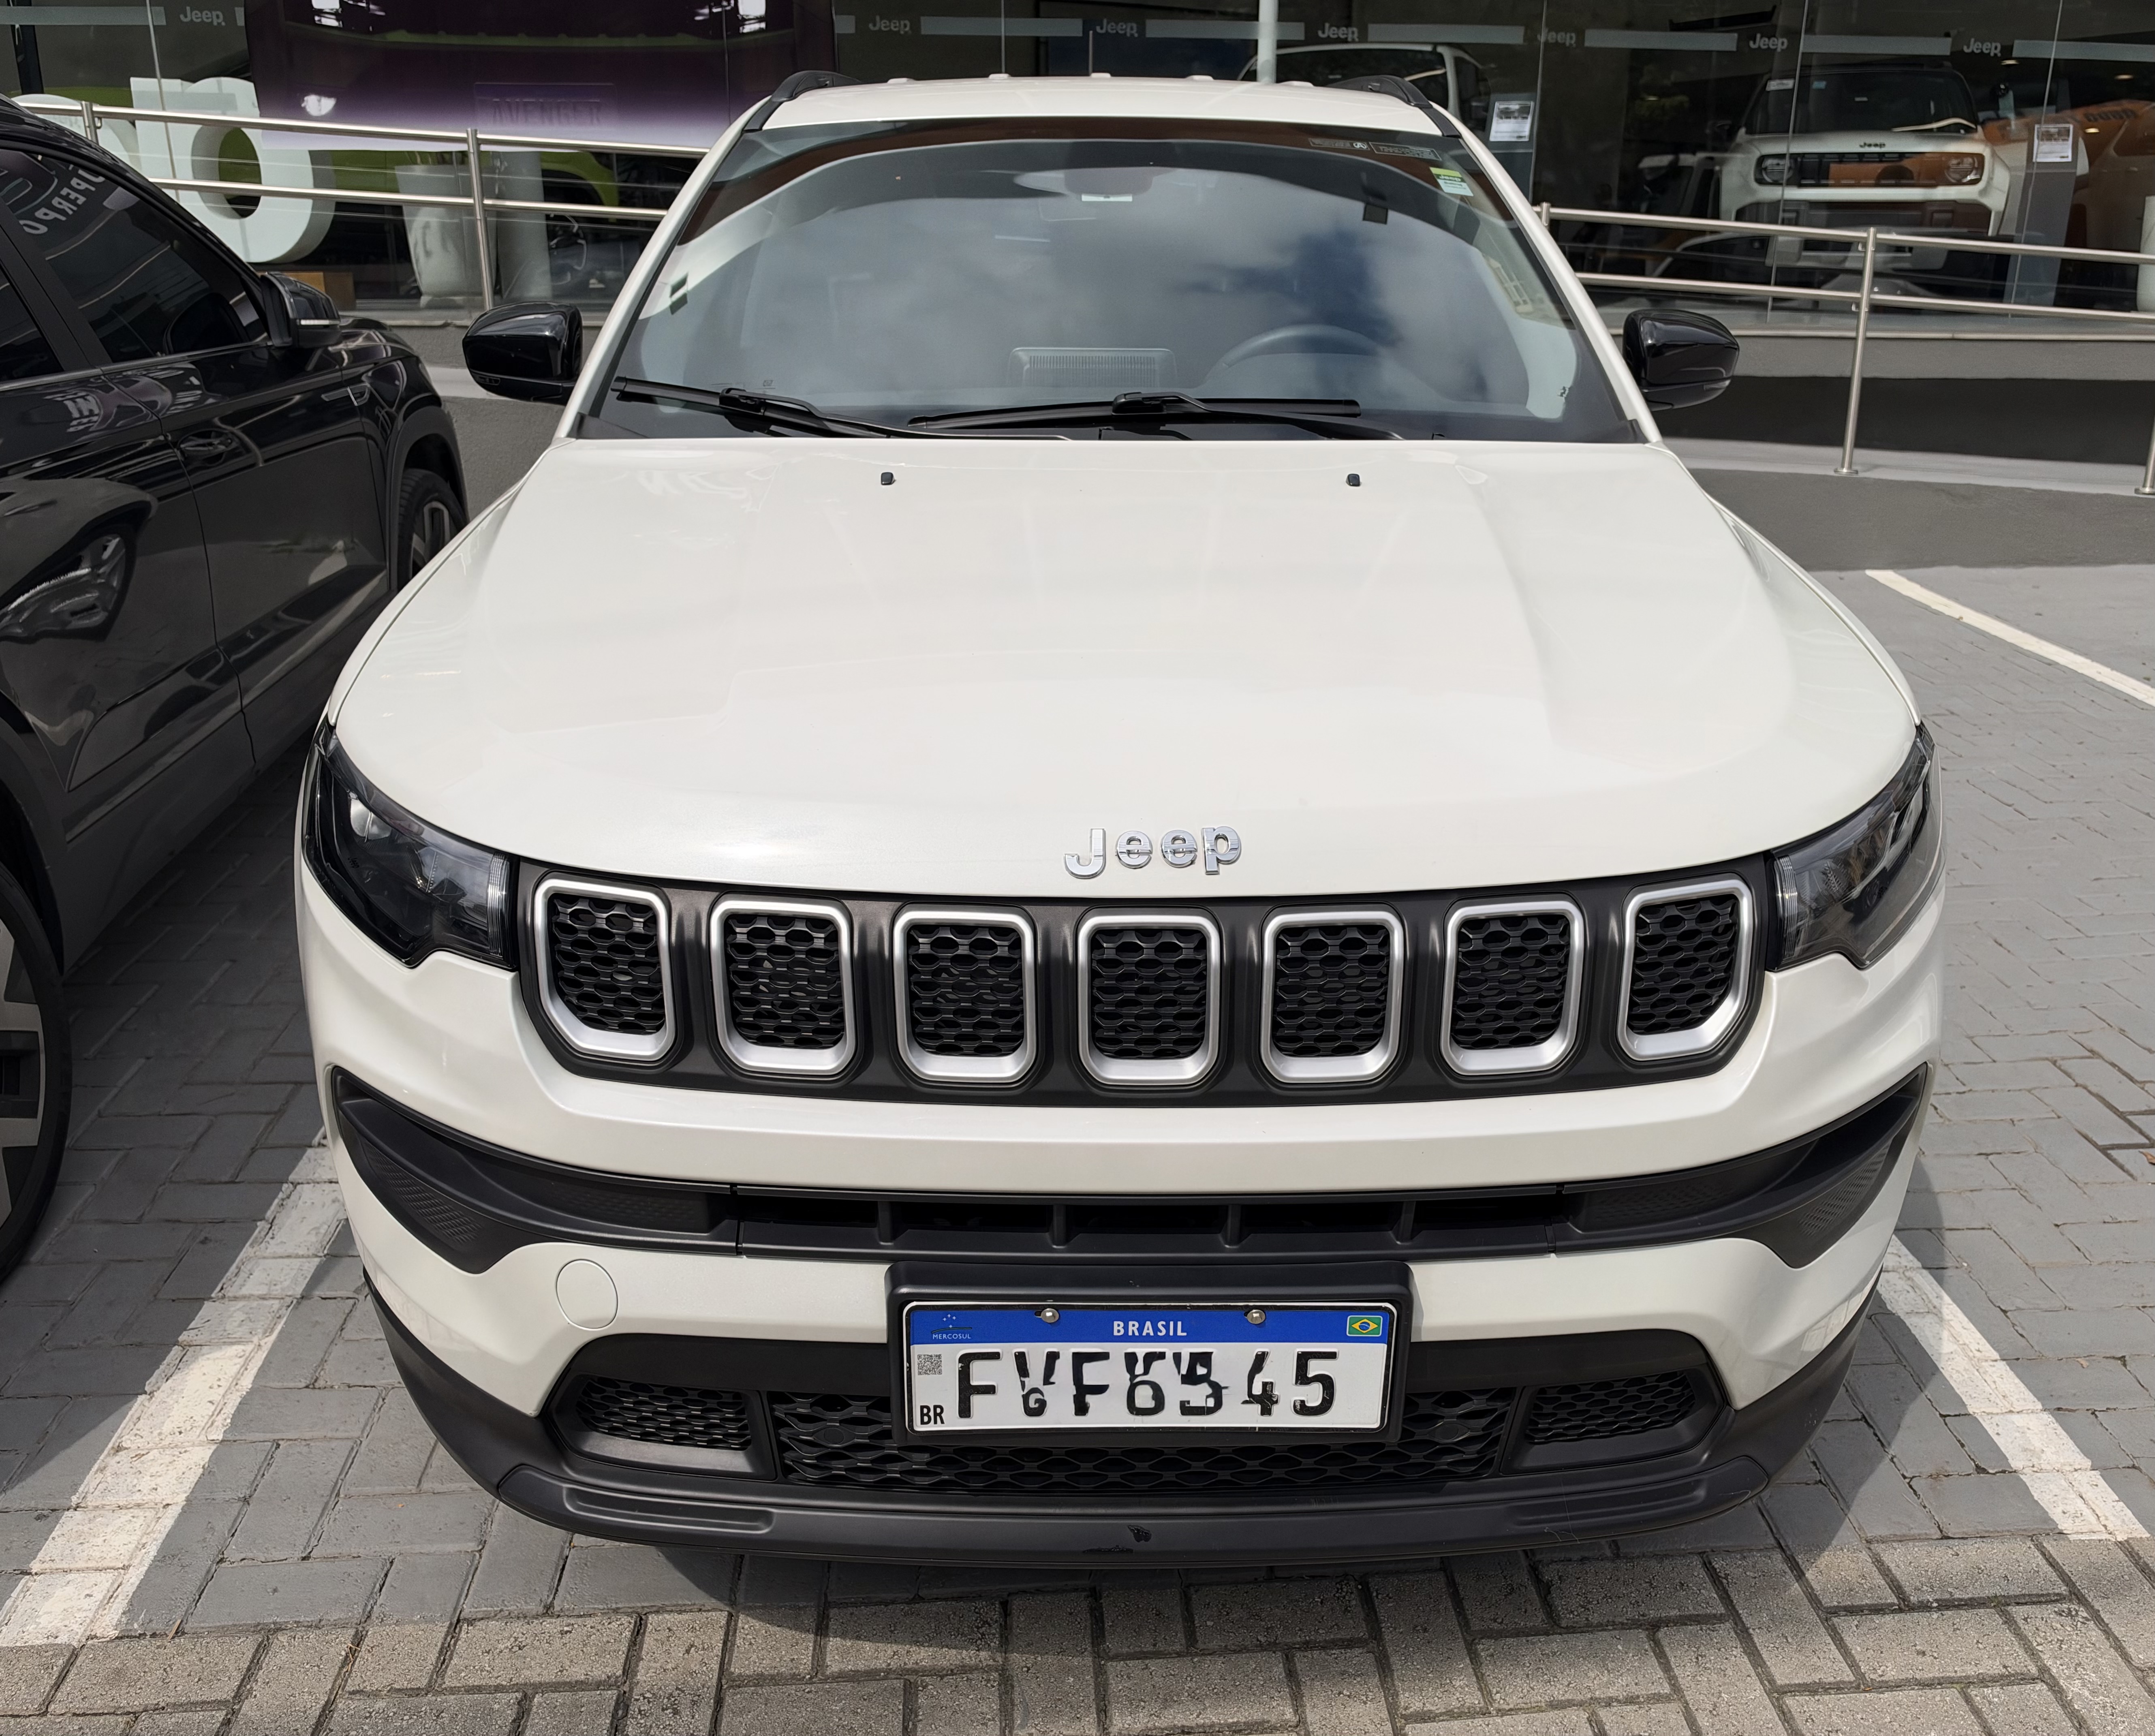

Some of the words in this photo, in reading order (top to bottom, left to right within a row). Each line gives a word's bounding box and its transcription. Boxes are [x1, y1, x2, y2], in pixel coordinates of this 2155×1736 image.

[180, 6, 225, 26] Jeep
[869, 16, 911, 34] Jeep
[1096, 19, 1138, 37] Jeep
[1318, 23, 1358, 41] Jeep
[1537, 27, 1576, 47] Jeep
[1749, 33, 1788, 52] Jeep
[1963, 38, 2001, 56] Jeep
[1064, 826, 1242, 879] Jeep
[1113, 1321, 1187, 1336] BRASIL
[919, 1405, 945, 1425] BR
